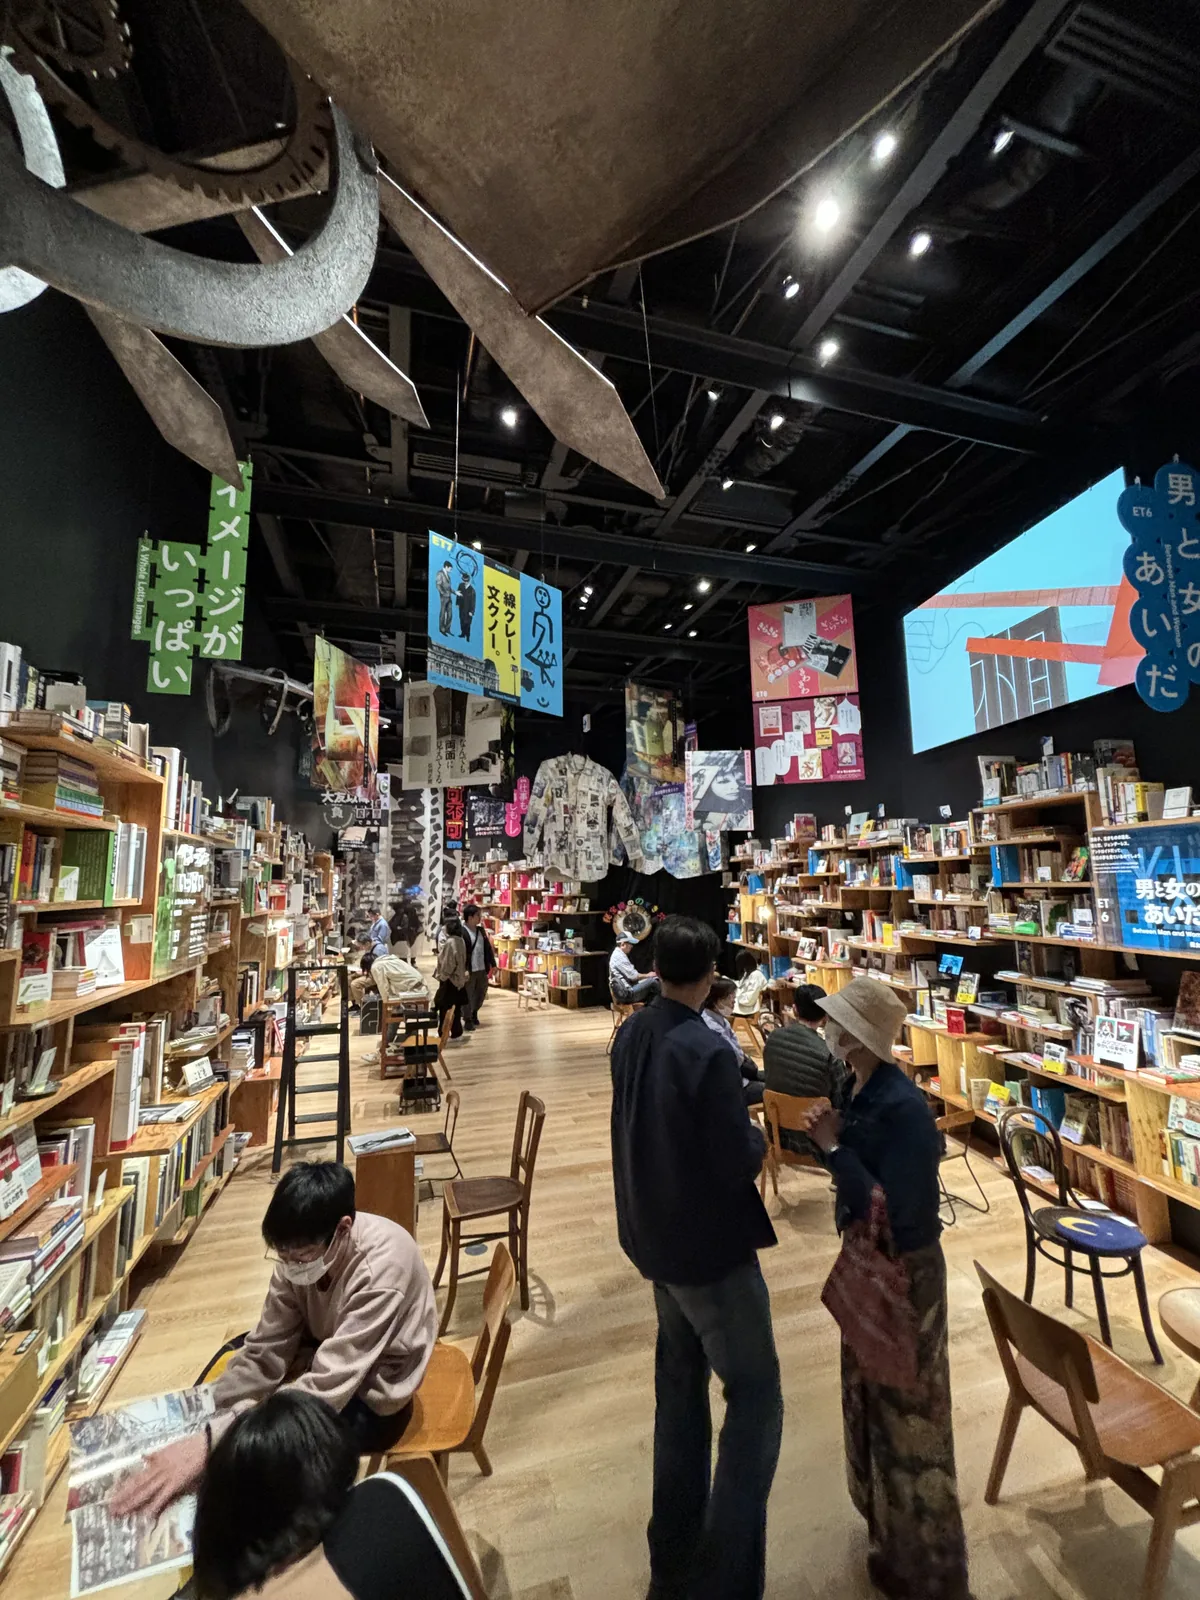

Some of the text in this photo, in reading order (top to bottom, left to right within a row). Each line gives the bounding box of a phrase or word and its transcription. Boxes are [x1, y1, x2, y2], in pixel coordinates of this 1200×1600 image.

[1132, 506, 1153, 518] ET6
[432, 535, 453, 552] ET7
[139, 554, 150, 580] Whole
[1164, 543, 1173, 579] Between
[1171, 599, 1179, 616] and
[136, 582, 148, 603] Lotta
[132, 604, 145, 635] Images
[153, 545, 197, 688] いっぱい
[487, 585, 501, 657] 文クノー。
[1135, 551, 1179, 698] あいだ
[1135, 878, 1200, 900] 男と女の
[1097, 898, 1110, 909] ET
[1101, 911, 1110, 923] 6
